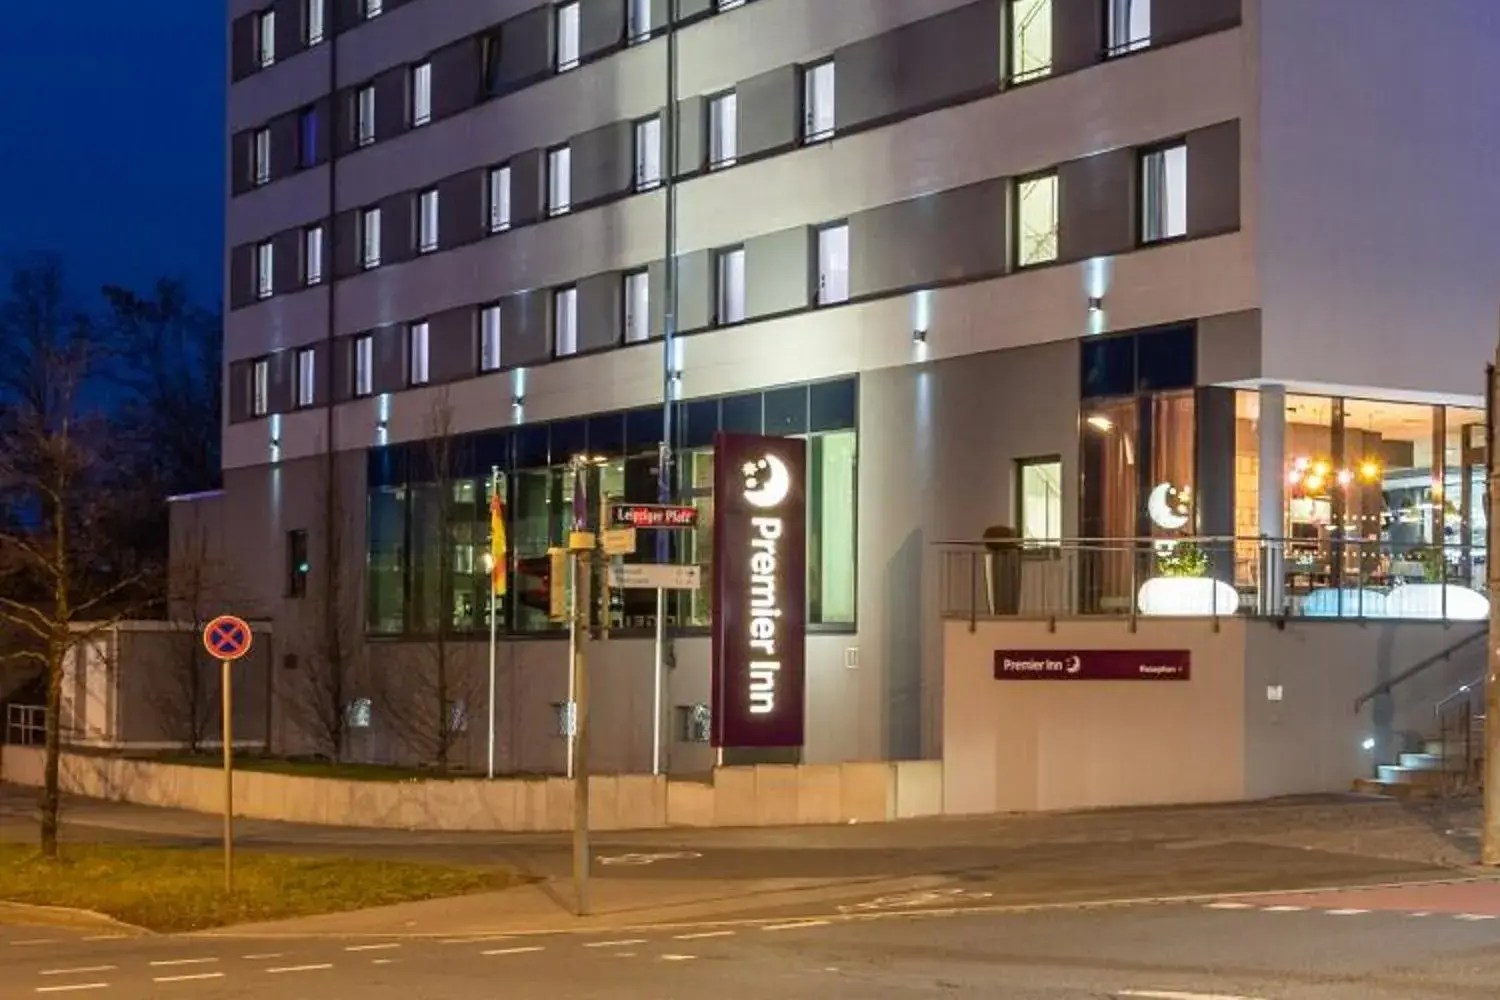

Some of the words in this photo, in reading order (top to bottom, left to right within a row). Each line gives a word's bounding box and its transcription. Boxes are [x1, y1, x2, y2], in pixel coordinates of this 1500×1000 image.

[750, 516, 783, 655] Premier
[749, 660, 782, 714] Inn
[1003, 658, 1045, 672] Premier
[1046, 658, 1063, 671] Inn
